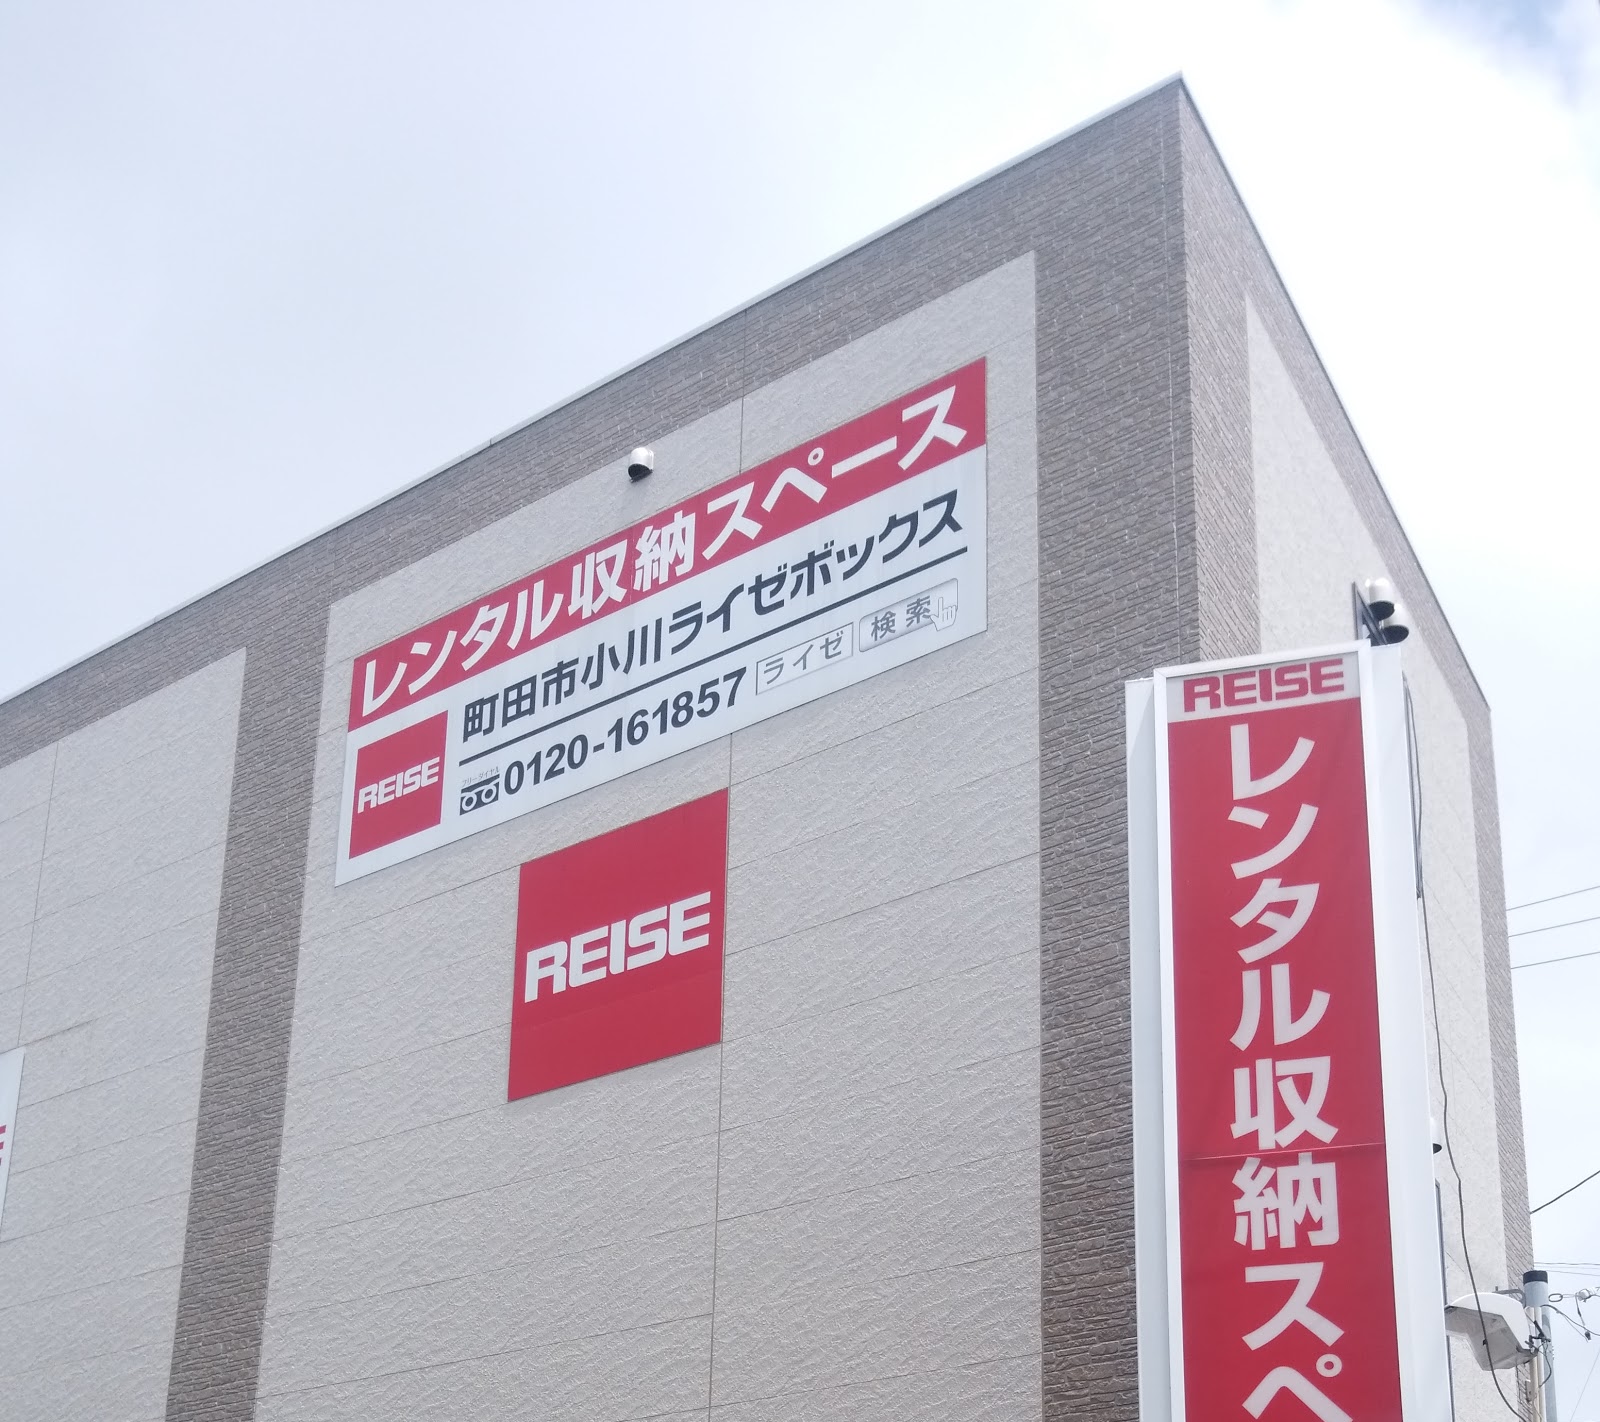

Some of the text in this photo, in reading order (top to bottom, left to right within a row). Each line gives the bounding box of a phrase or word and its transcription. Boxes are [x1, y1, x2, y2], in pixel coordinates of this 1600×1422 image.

[361, 385, 967, 716] レンタル収納スペース
[463, 489, 963, 744] 町田市小川ライゼボックス
[763, 595, 931, 685] ライゼ 検索
[504, 667, 747, 795] 0120-161857
[1183, 658, 1345, 712] REISE
[357, 756, 440, 814] REISE
[525, 891, 711, 1003] REISE
